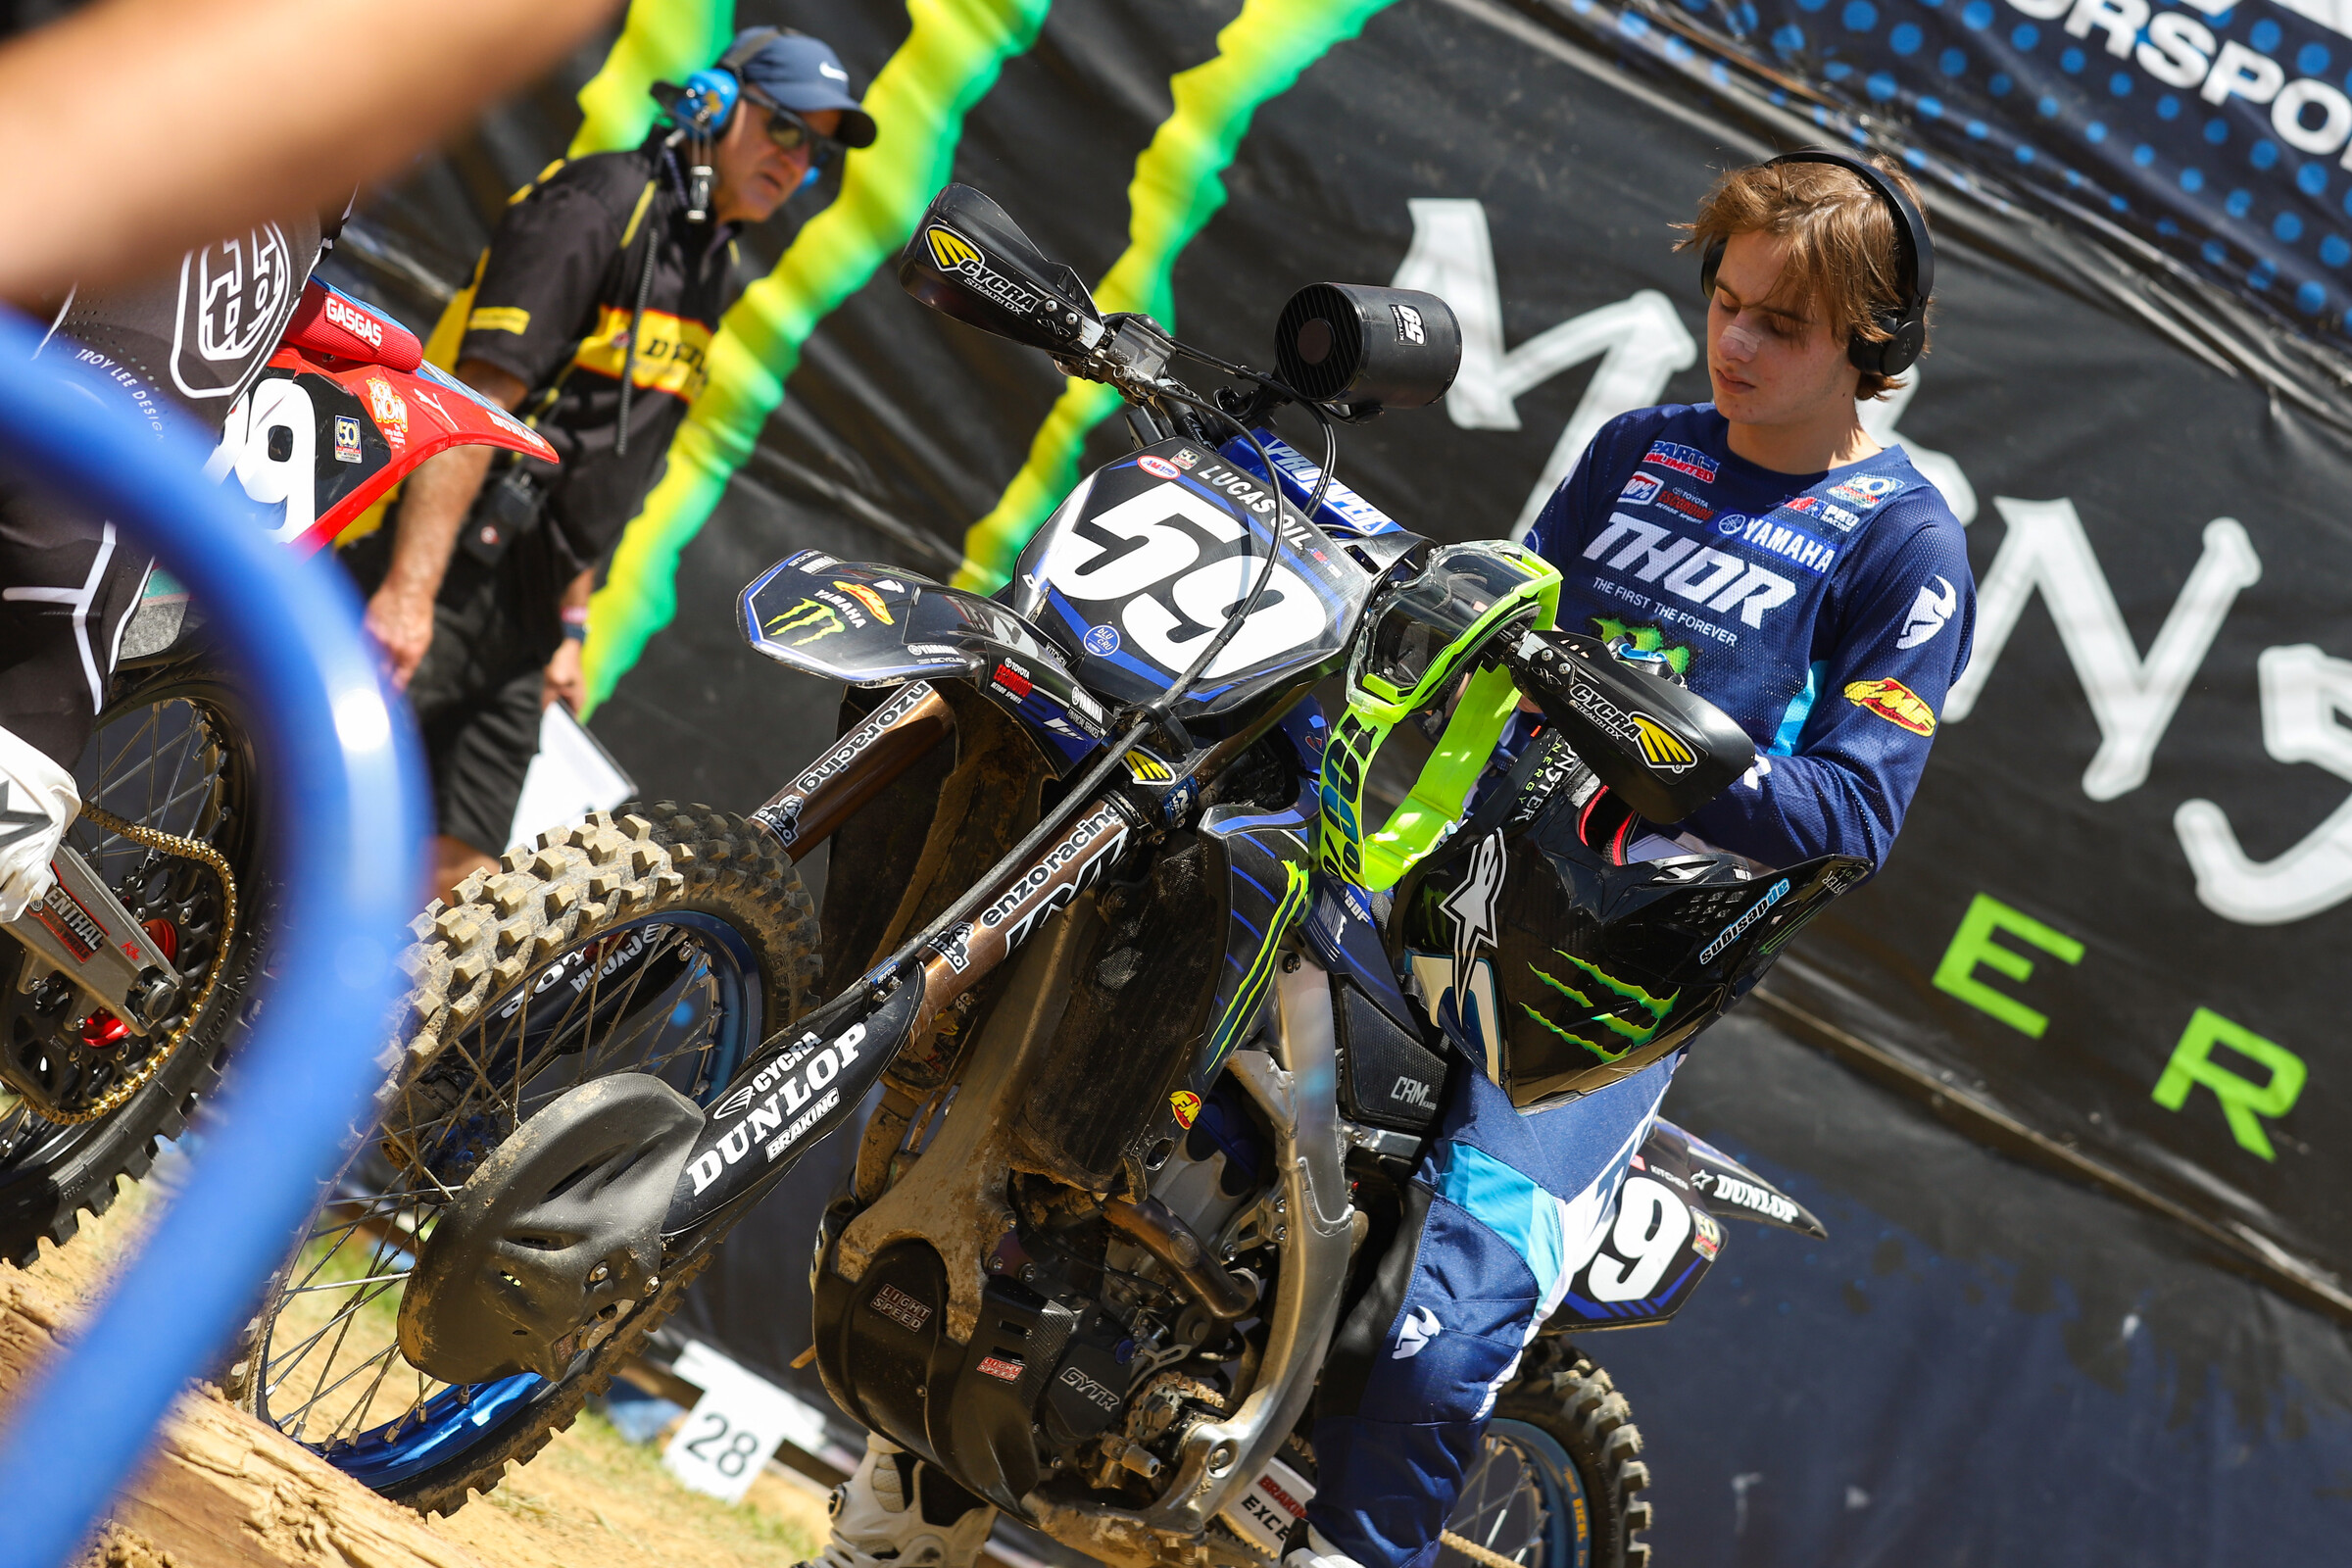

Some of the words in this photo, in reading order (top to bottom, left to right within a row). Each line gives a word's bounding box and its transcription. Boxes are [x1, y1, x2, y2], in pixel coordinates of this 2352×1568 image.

[2004, 0, 2352, 176] RSPO
[957, 258, 1041, 313] CYCRA
[964, 277, 1005, 306] STEALTH
[1004, 303, 1023, 316] DX
[326, 297, 382, 347] GASGAS
[1397, 304, 1425, 345] 59
[74, 348, 116, 369] TROY
[109, 367, 138, 388] LEE
[338, 421, 358, 446] 50
[1650, 440, 1720, 473] PARTS
[1198, 465, 1277, 513] LUCAS
[1270, 514, 1313, 548] OIL
[1682, 492, 1708, 509] TOYOTA
[1820, 514, 1852, 533] RACING
[1823, 504, 1859, 527] PRO
[1741, 518, 1837, 574] YAMAHA
[1047, 481, 1327, 679] 59
[1582, 511, 1795, 630] THOR
[813, 589, 867, 629] YAMAHA
[1594, 576, 1613, 595] THE
[1614, 585, 1650, 610] FIRST
[1655, 602, 1675, 621] THE
[1674, 611, 1738, 648] FOREVER
[1011, 661, 1030, 680] TOYOTA
[1570, 683, 1644, 742] CYCRA
[1605, 726, 1623, 741] DX
[1514, 742, 1578, 821] NSTER
[1518, 742, 1562, 805] NERGY
[759, 808, 793, 842] enzo
[43, 887, 104, 951] ENTHAL
[1699, 878, 1790, 965] apdesigns
[752, 1031, 822, 1093] CYCRA
[686, 1022, 867, 1197] DUNLOP
[1391, 1076, 1430, 1105] CRM
[767, 1089, 840, 1161] BRAKING
[1713, 1174, 1799, 1223] DUNLOP
[871, 1297, 924, 1331] SPEED
[881, 1285, 931, 1318] LIGHT
[979, 1364, 1017, 1381] SPEED
[983, 1357, 1022, 1374] LIGHT
[1059, 1367, 1120, 1412] GYTR
[687, 1412, 759, 1478] 28
[1241, 1494, 1290, 1542] EXCE
